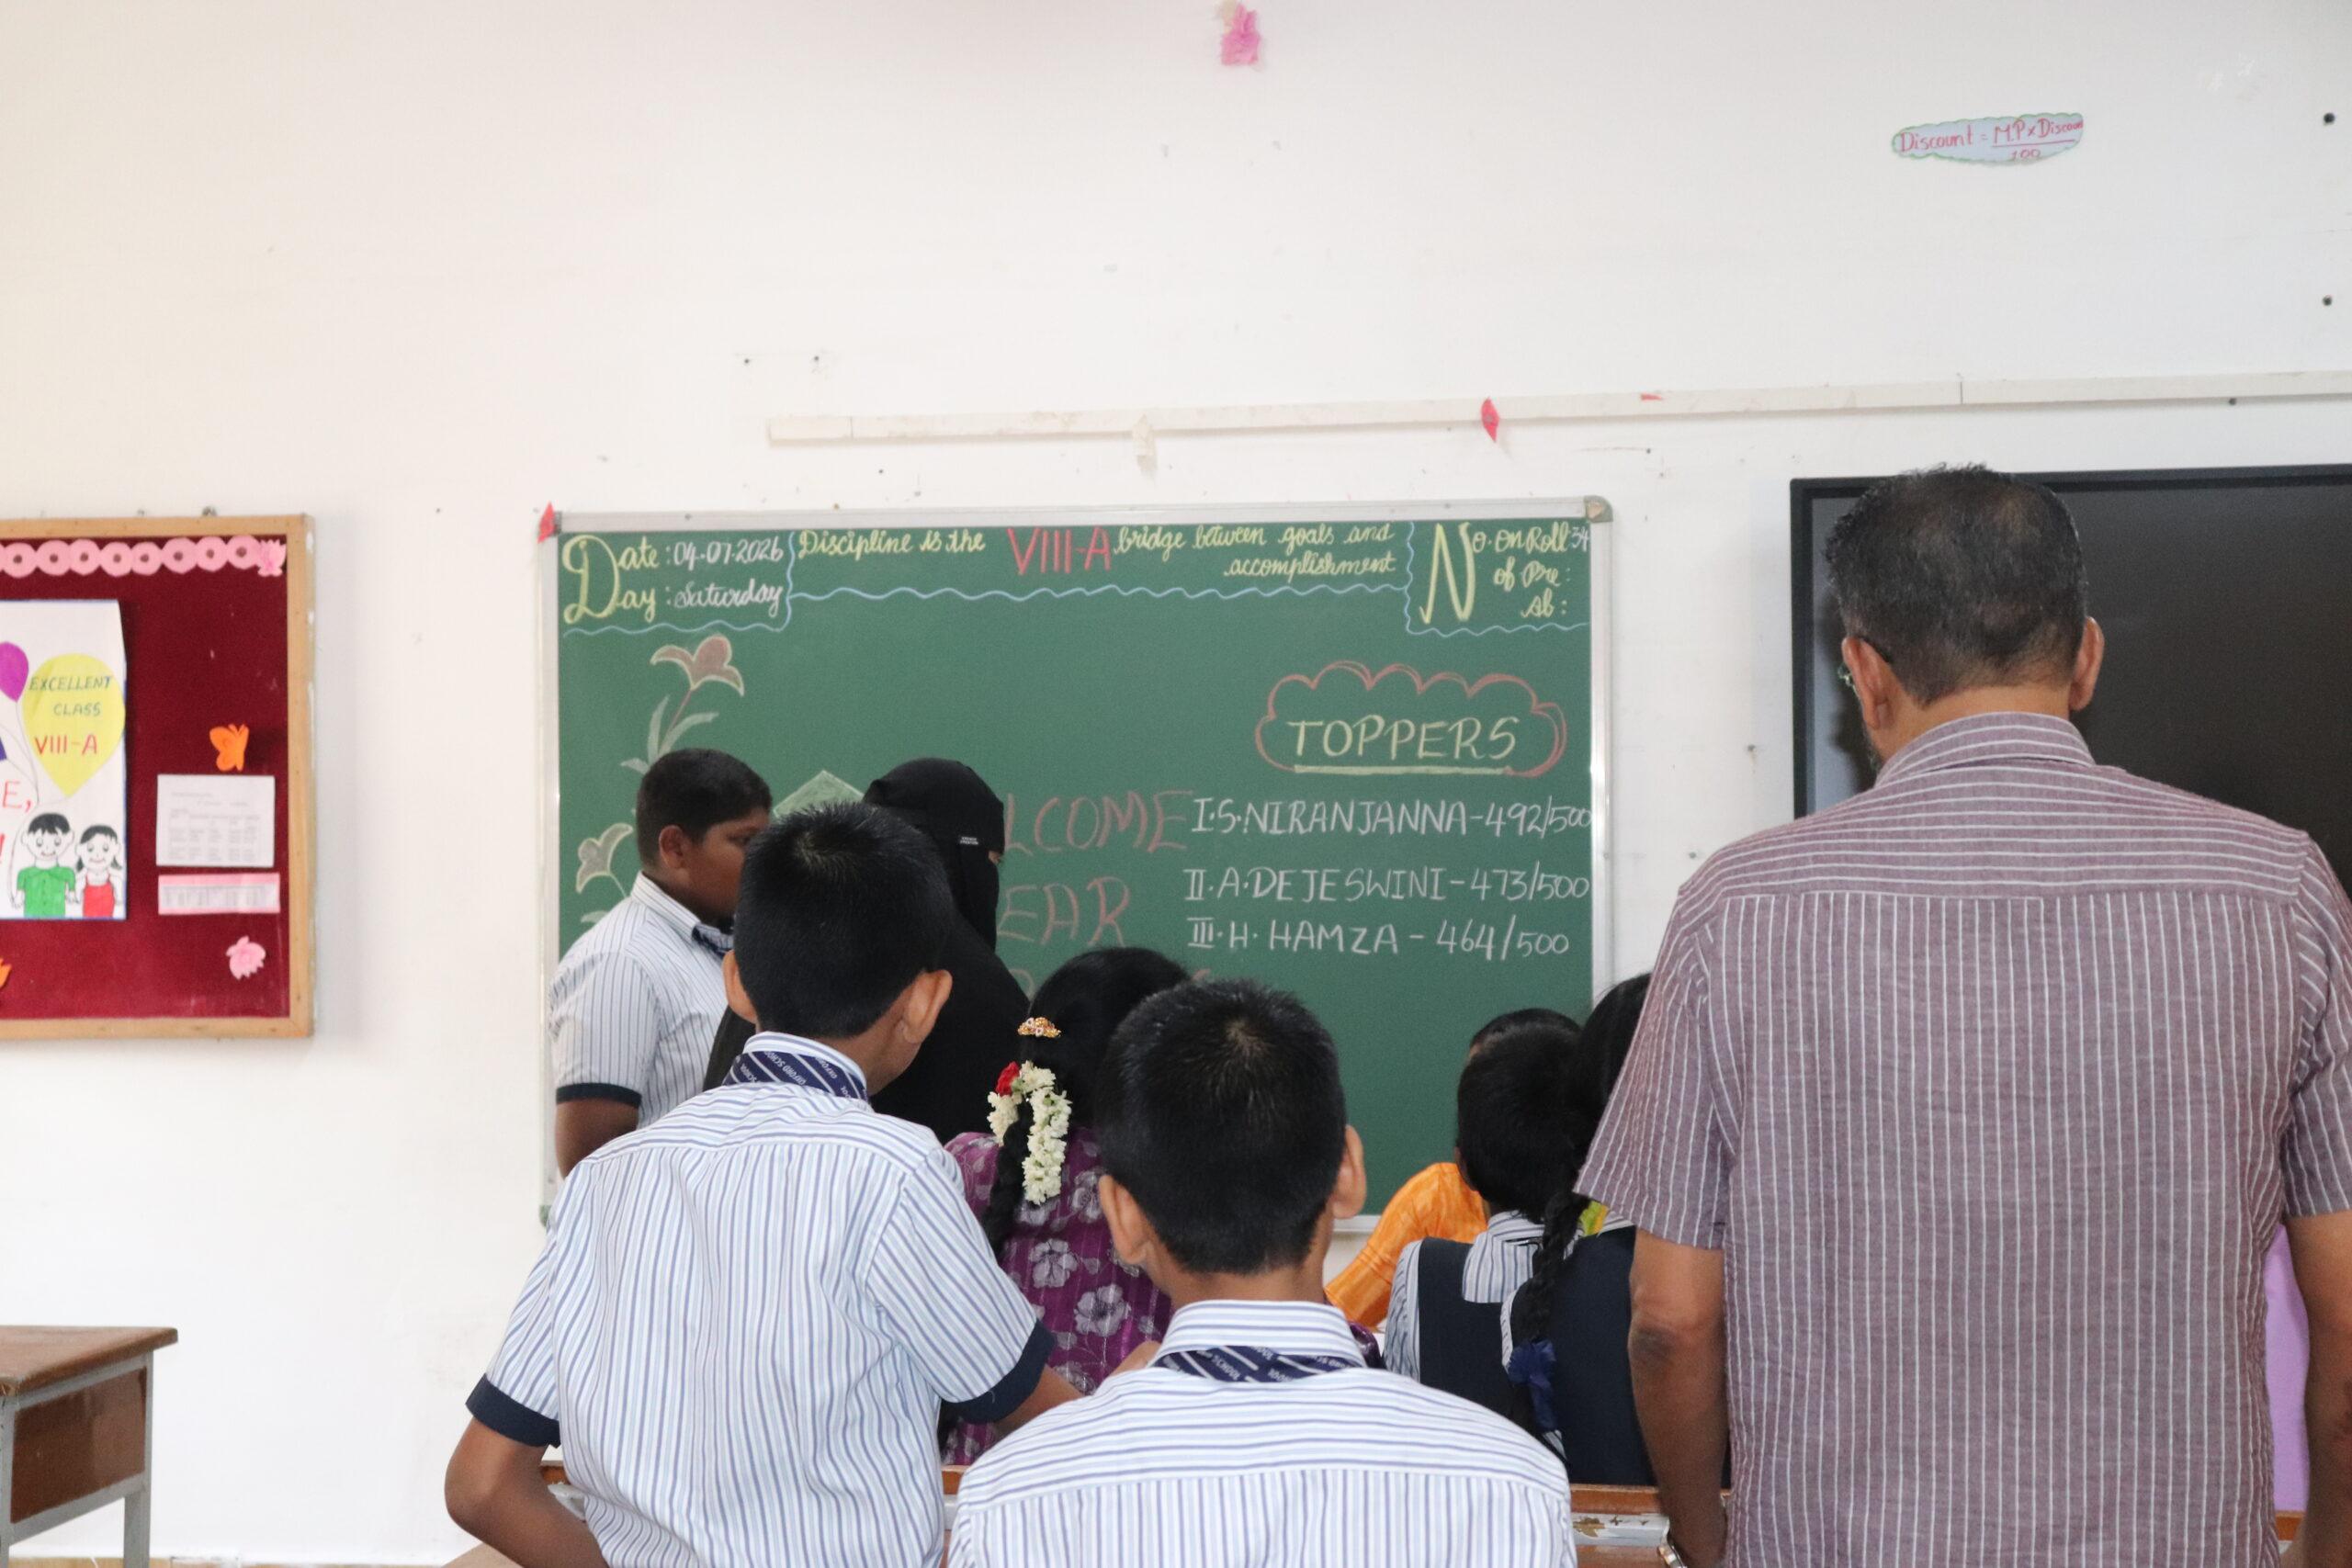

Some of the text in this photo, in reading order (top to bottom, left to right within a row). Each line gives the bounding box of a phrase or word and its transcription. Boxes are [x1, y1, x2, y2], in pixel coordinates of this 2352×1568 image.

[1899, 124, 1973, 153] Discount
[2011, 149, 2041, 163] 100
[797, 529, 914, 561] Discipline
[920, 529, 943, 552] is
[945, 528, 987, 553] the
[1005, 526, 1113, 576] VIII-A
[1114, 525, 1187, 562] bridge
[1278, 524, 1334, 556] goals
[1343, 523, 1396, 545] and
[1224, 550, 1396, 583] accomplishment
[28, 675, 111, 692] EXCELLENT
[52, 701, 101, 717] CLASS
[34, 732, 97, 755] VIII-A
[1287, 715, 1521, 760] TOPPERS
[1004, 790, 1193, 856] LCOME
[996, 875, 1131, 948] EAR
[1270, 920, 1398, 955] HAMZA
